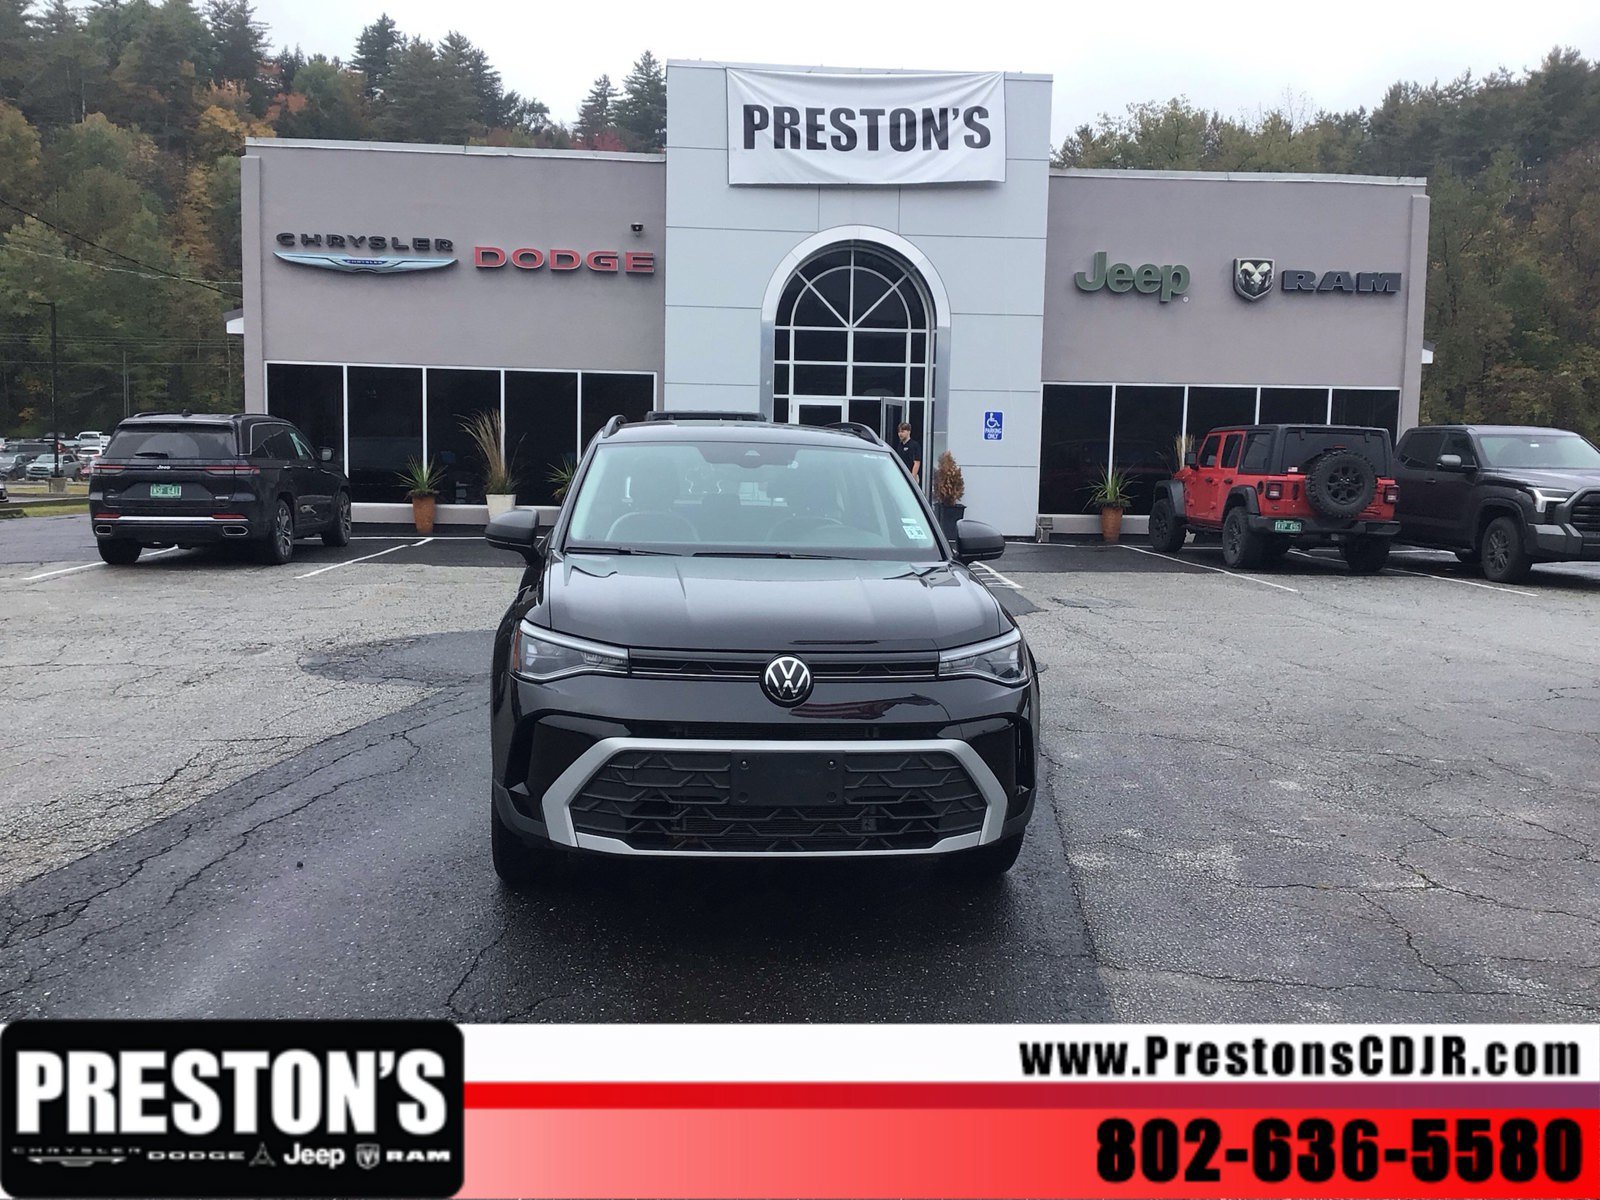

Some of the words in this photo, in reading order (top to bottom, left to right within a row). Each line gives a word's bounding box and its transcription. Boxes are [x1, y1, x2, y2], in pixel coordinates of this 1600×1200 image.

[743, 104, 991, 152] PRESTON'S
[275, 232, 454, 252] CHRYSLER
[474, 246, 655, 273] DODGE
[1074, 251, 1191, 303] Jeep
[1281, 269, 1402, 294] RAM
